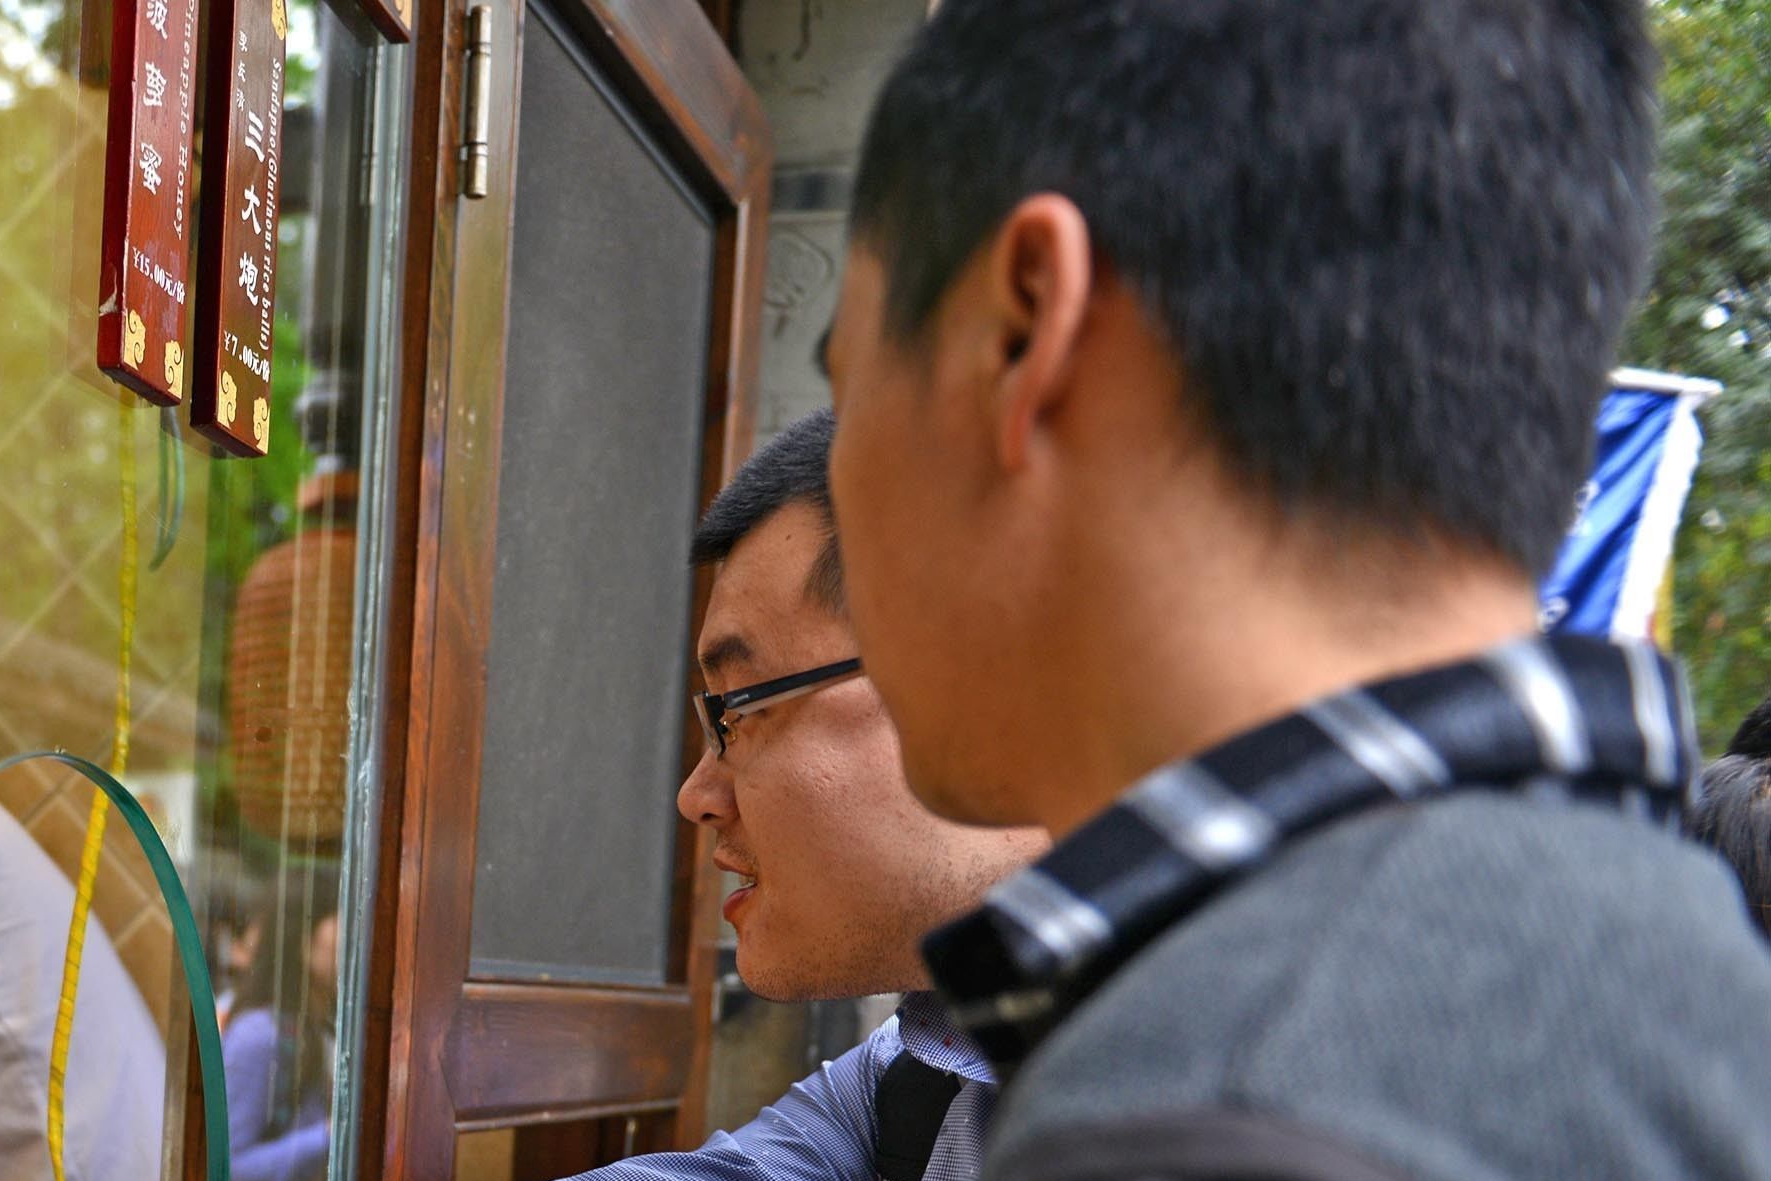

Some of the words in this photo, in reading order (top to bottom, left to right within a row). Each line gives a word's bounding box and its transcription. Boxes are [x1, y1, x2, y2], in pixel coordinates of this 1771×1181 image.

[173, 142, 189, 240] Honey
[239, 111, 265, 306] 三大炮
[262, 255, 273, 293] rice
[258, 297, 271, 351] balls)
